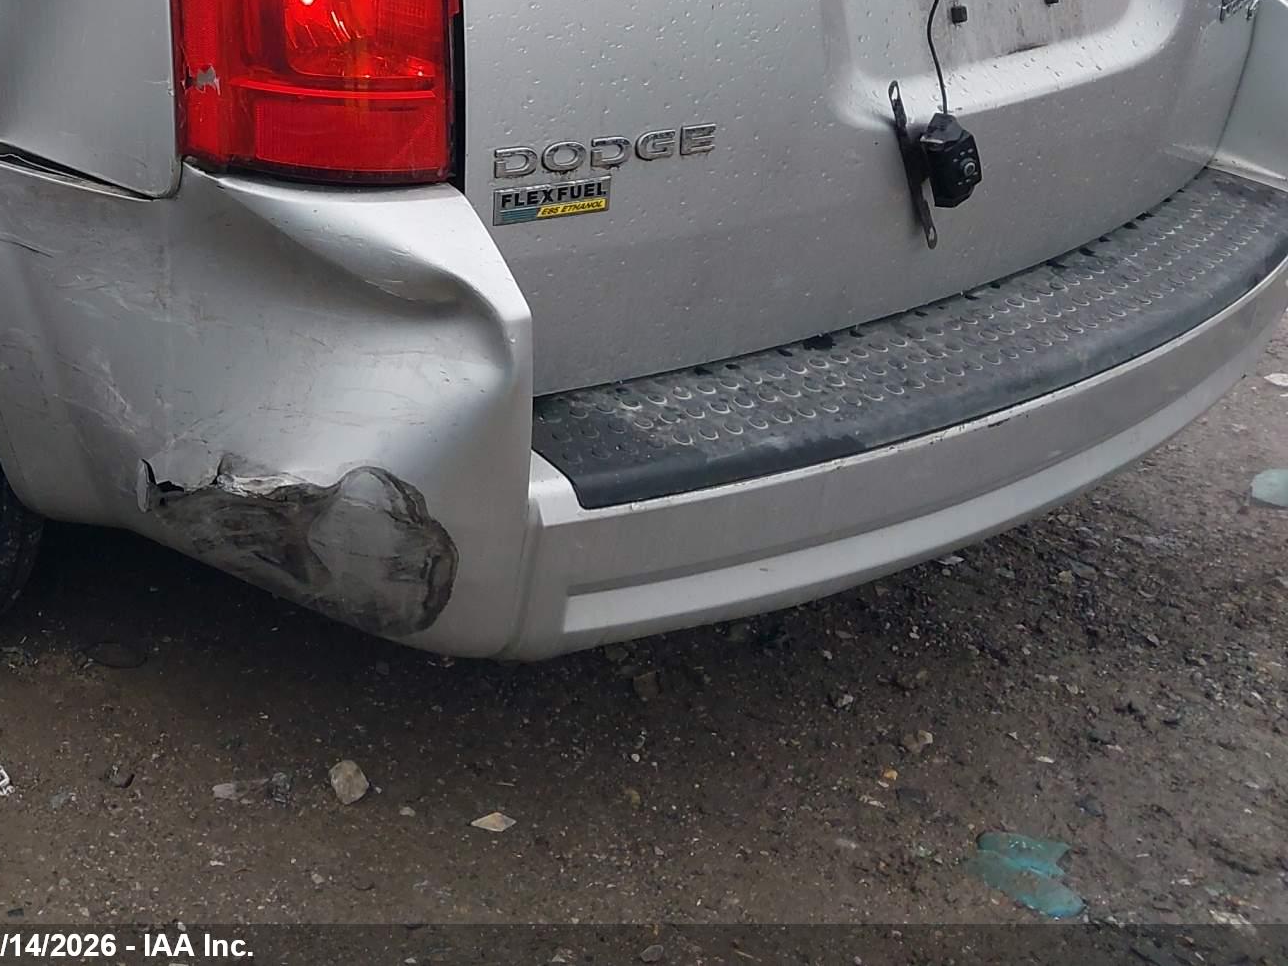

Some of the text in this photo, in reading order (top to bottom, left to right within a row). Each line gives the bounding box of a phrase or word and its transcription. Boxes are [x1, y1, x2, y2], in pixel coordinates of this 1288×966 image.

[494, 123, 717, 179] DODGE
[541, 200, 605, 216] E85 ETHANOL
